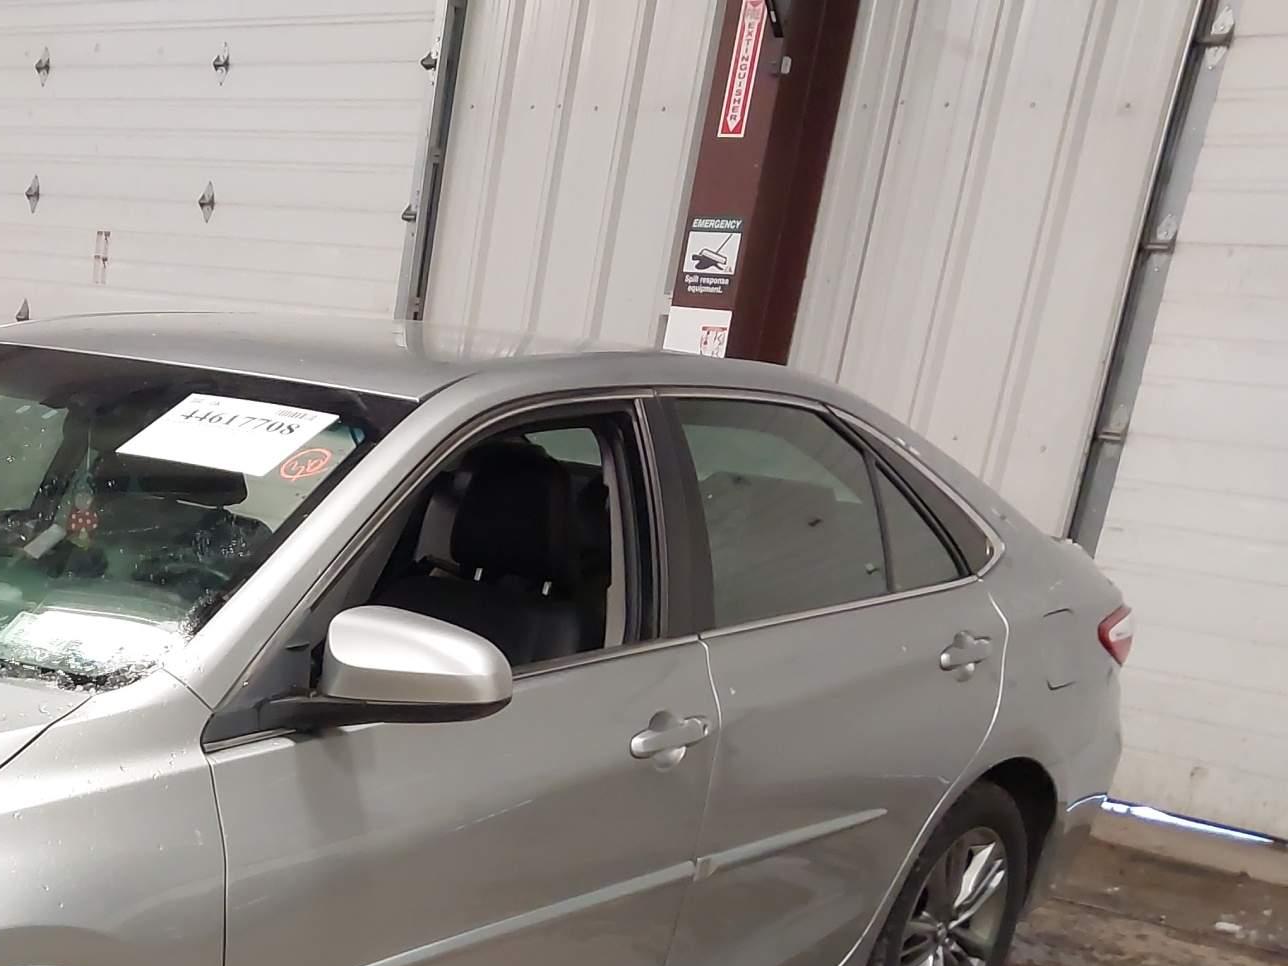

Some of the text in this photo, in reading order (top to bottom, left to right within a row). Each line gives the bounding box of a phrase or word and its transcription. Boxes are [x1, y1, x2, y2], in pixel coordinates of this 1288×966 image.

[729, 21, 755, 121] EXTINGUISHER
[692, 218, 743, 229] EMERGENCY
[684, 274, 730, 286] Spill response
[180, 408, 301, 436] 44617708
